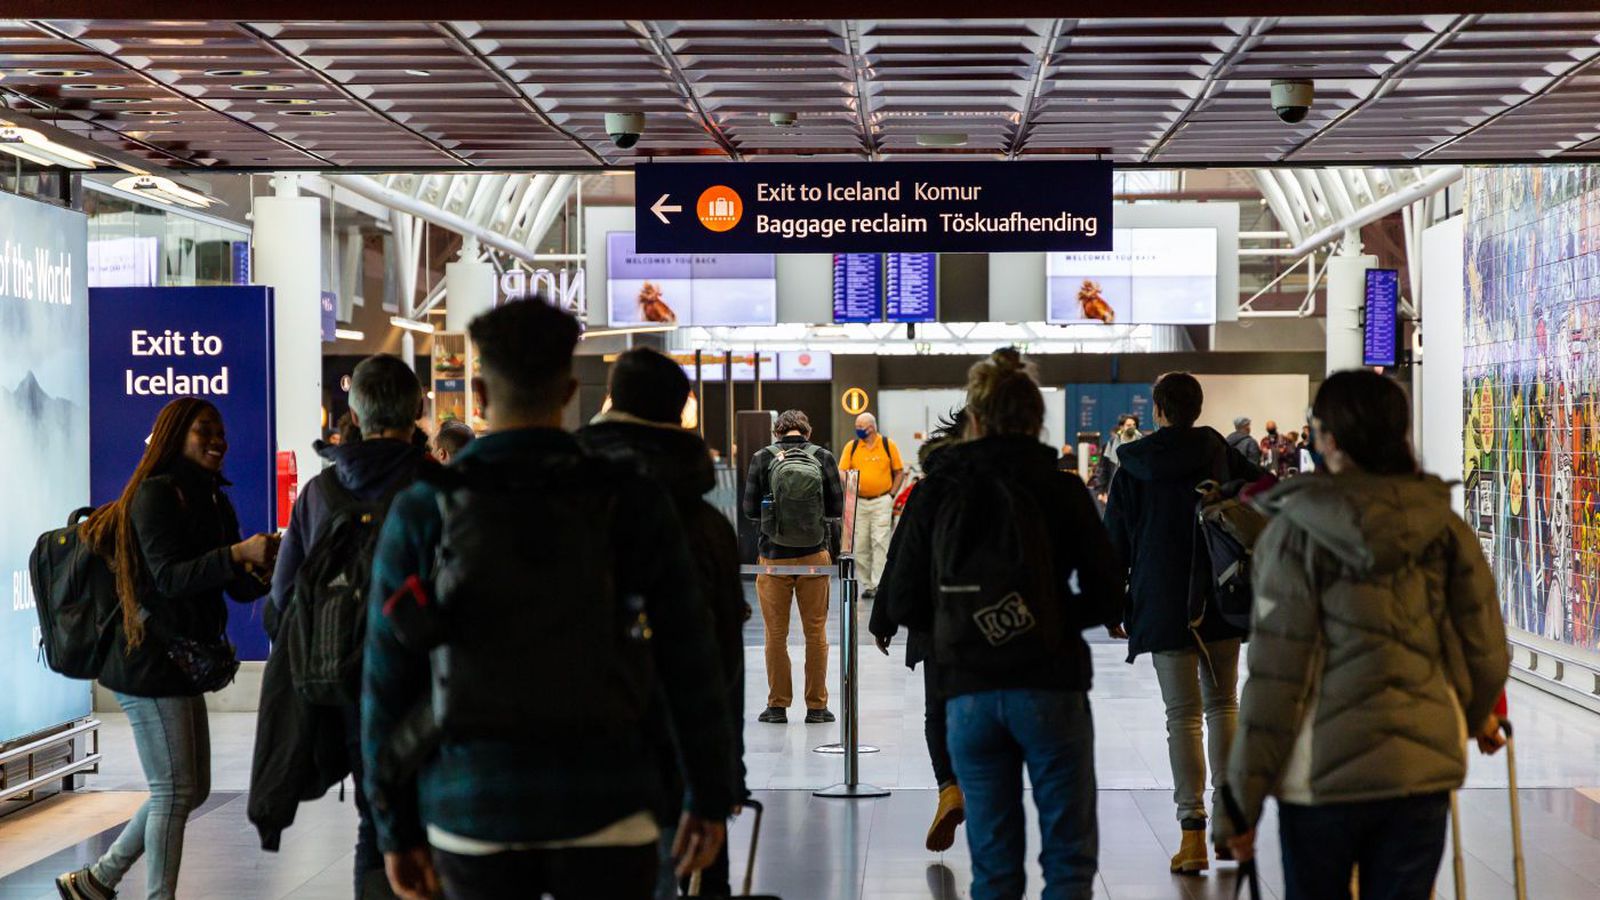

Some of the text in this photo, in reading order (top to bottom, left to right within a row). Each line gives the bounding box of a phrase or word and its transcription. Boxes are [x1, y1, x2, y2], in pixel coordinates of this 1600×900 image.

[756, 180, 982, 202] Exit to Iceland Komur
[756, 211, 1097, 239] Baggage reclaim Töskuafhending
[12, 242, 33, 300] the
[35, 246, 72, 305] World
[131, 329, 223, 356] Exit to
[125, 366, 229, 395] Iceland
